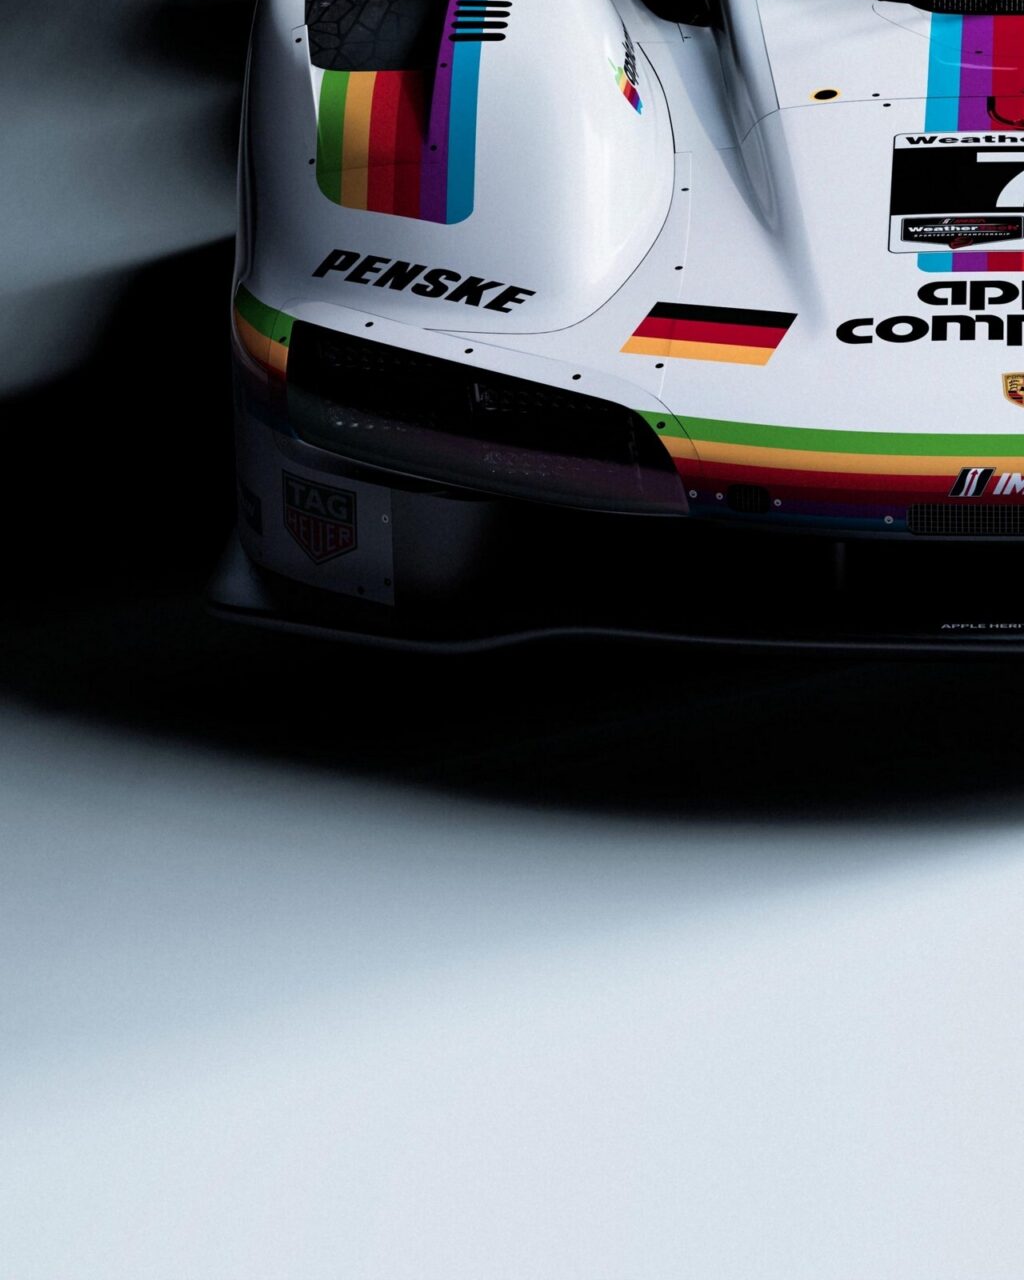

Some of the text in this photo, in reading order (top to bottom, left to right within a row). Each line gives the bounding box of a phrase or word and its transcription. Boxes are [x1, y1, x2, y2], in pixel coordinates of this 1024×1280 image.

[312, 248, 537, 313] PENSKE
[286, 480, 349, 521] TAG
[287, 509, 353, 558] HEUER
